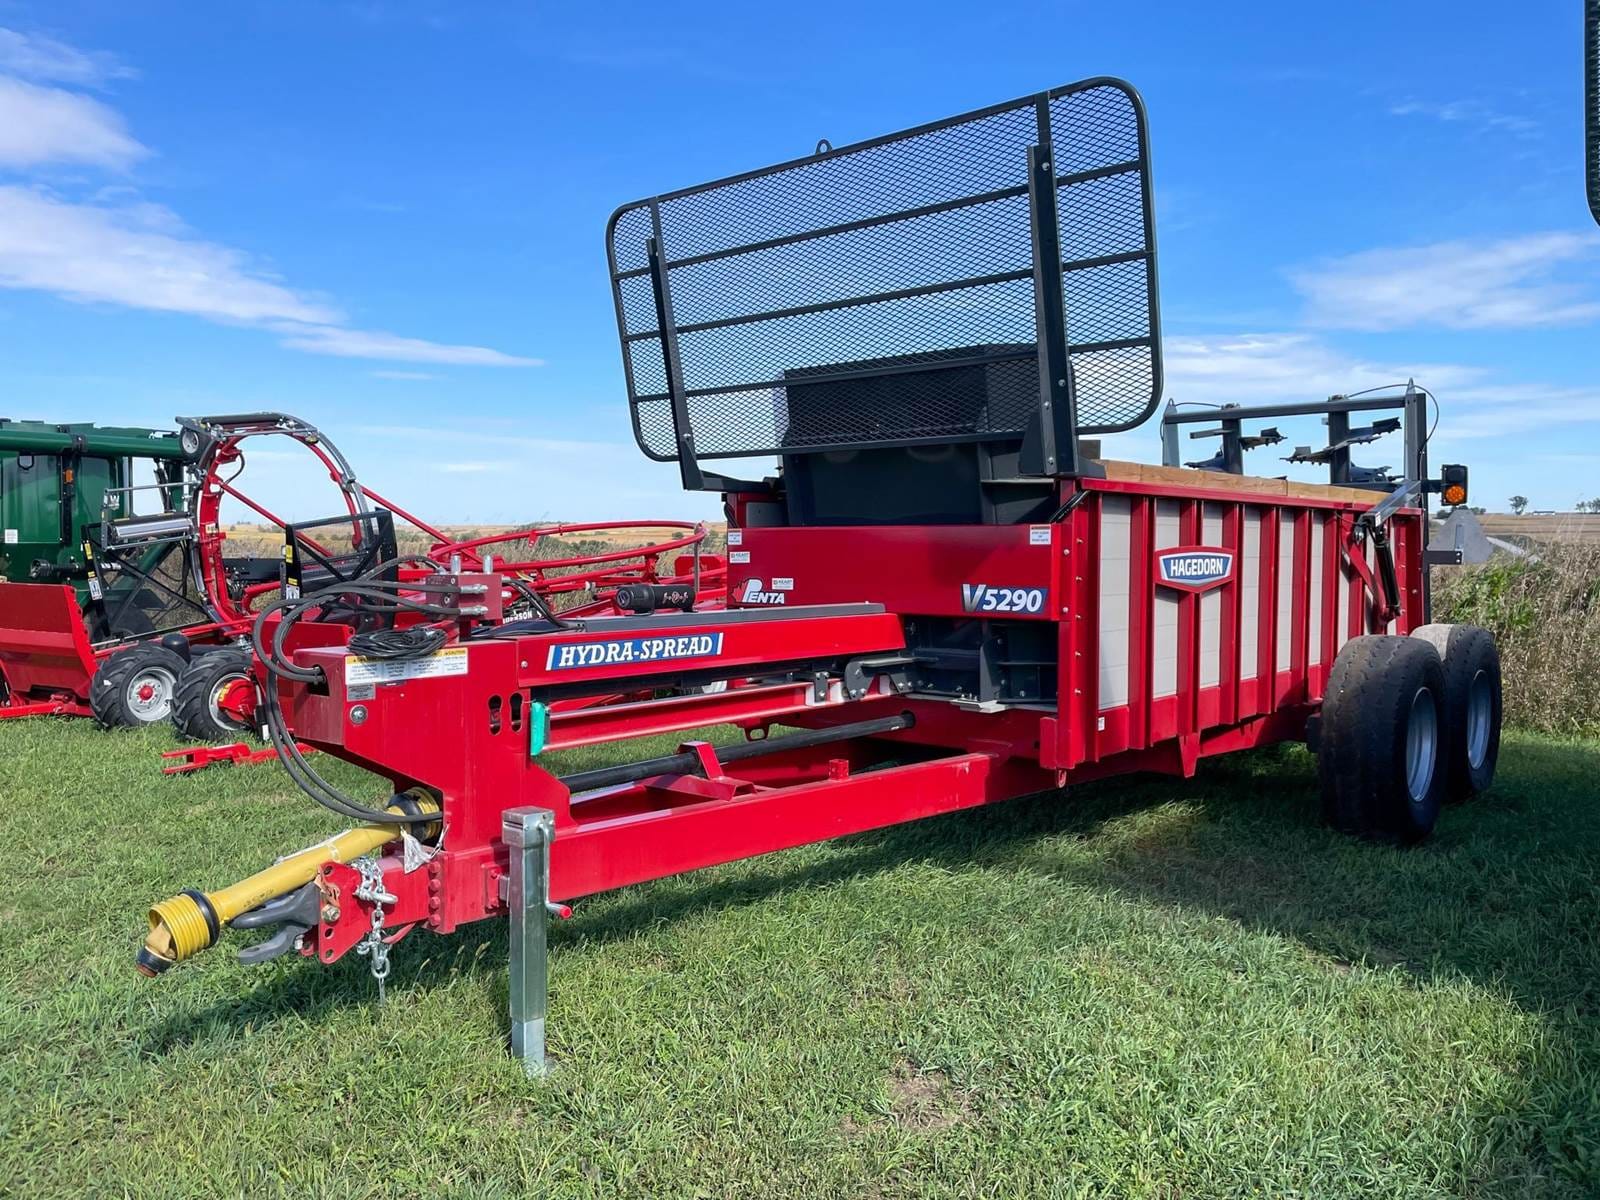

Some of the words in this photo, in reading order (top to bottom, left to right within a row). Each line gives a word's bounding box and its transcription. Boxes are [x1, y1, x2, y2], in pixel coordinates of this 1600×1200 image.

[1170, 558, 1223, 577] HAGEDORN
[742, 578, 785, 604] PENTA
[962, 583, 1043, 613] V5290
[558, 635, 713, 667] HYDRA-SPREAD
